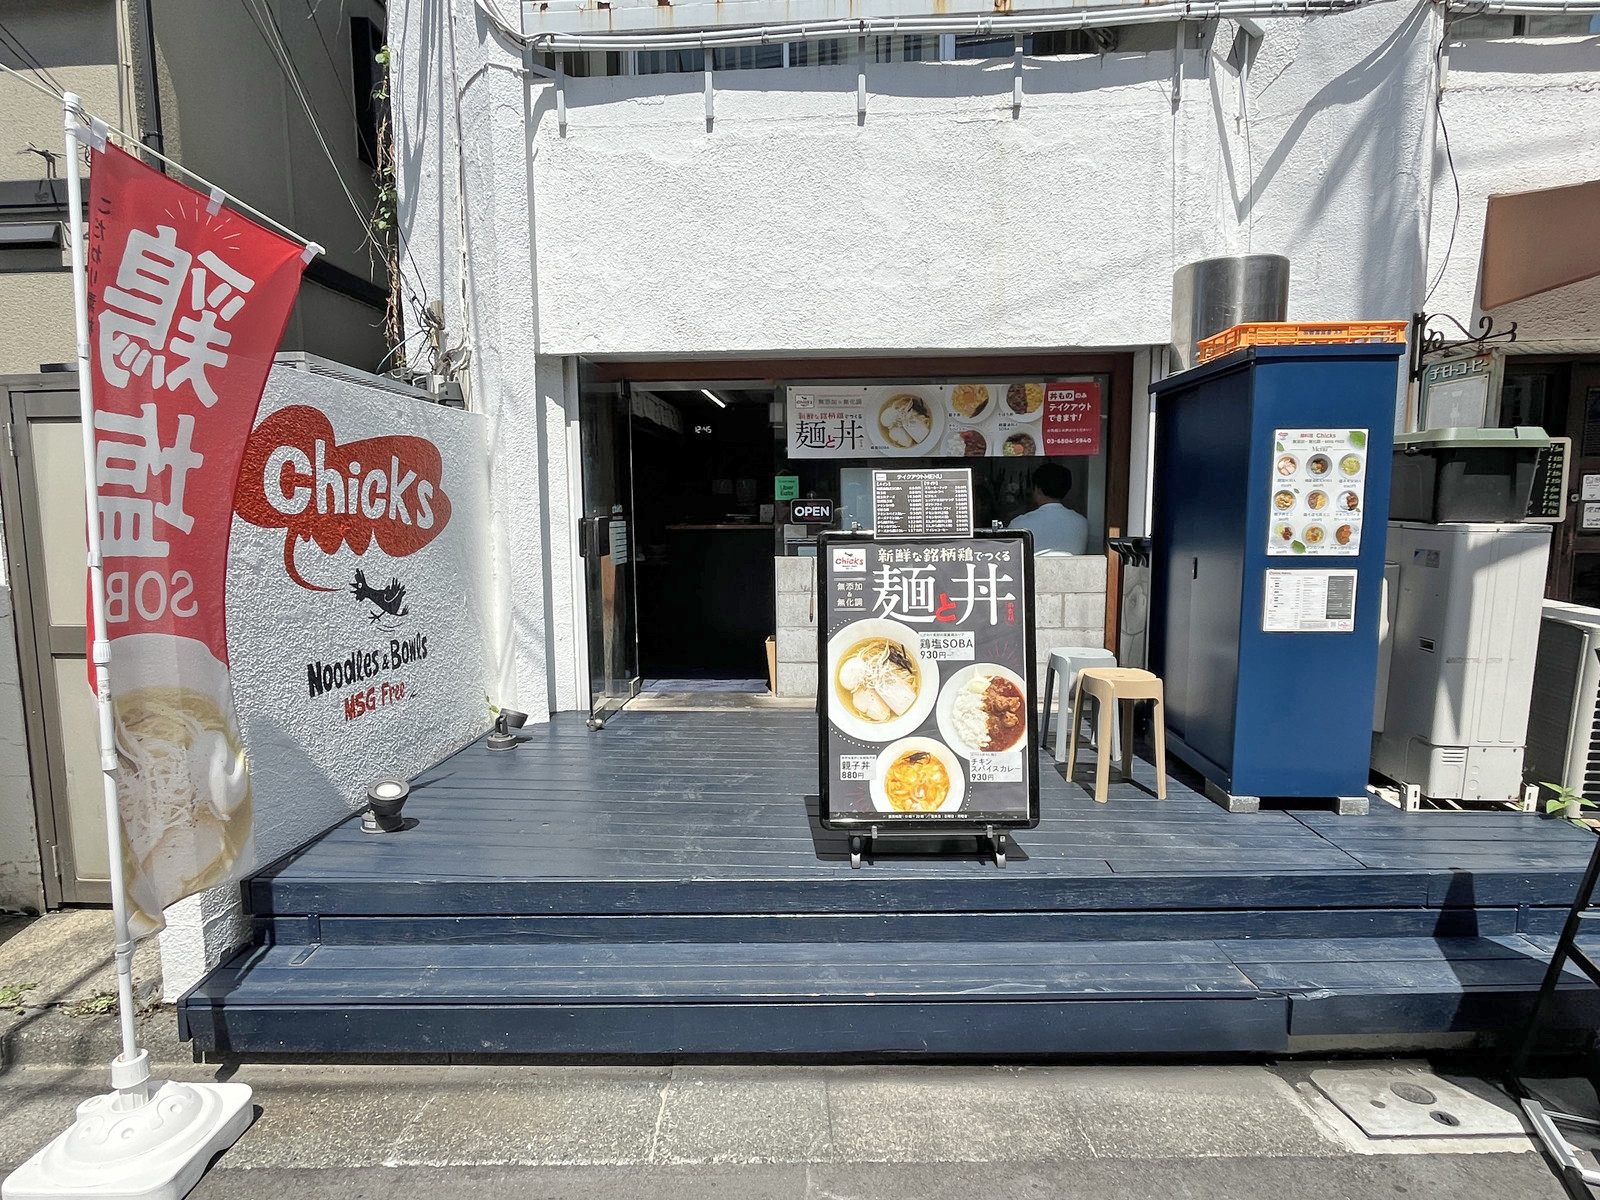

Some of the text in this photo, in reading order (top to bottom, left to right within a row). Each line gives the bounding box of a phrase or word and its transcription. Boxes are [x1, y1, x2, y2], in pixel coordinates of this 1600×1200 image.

[1430, 359, 1489, 380] チモトコーヒー
[1049, 402, 1092, 412] テイクアウト
[796, 420, 865, 450] 麺と丼
[263, 439, 435, 529] Chicks
[794, 506, 830, 517] OPEN
[877, 546, 1012, 563] 新鮮な銘柄鶏でつくる
[837, 582, 863, 591] 無添加
[871, 563, 1017, 626] 麺と丼
[837, 597, 863, 607] 無化調
[920, 638, 973, 649] 鶏塩SOBA
[307, 631, 428, 698] Noodles & Bowls
[343, 681, 406, 722] MSG Free
[842, 760, 871, 771] 親子丼
[971, 758, 992, 766] チキン
[971, 765, 1021, 773] スパイスカレー
[842, 771, 865, 779] 880円
[971, 773, 995, 781] 930円
